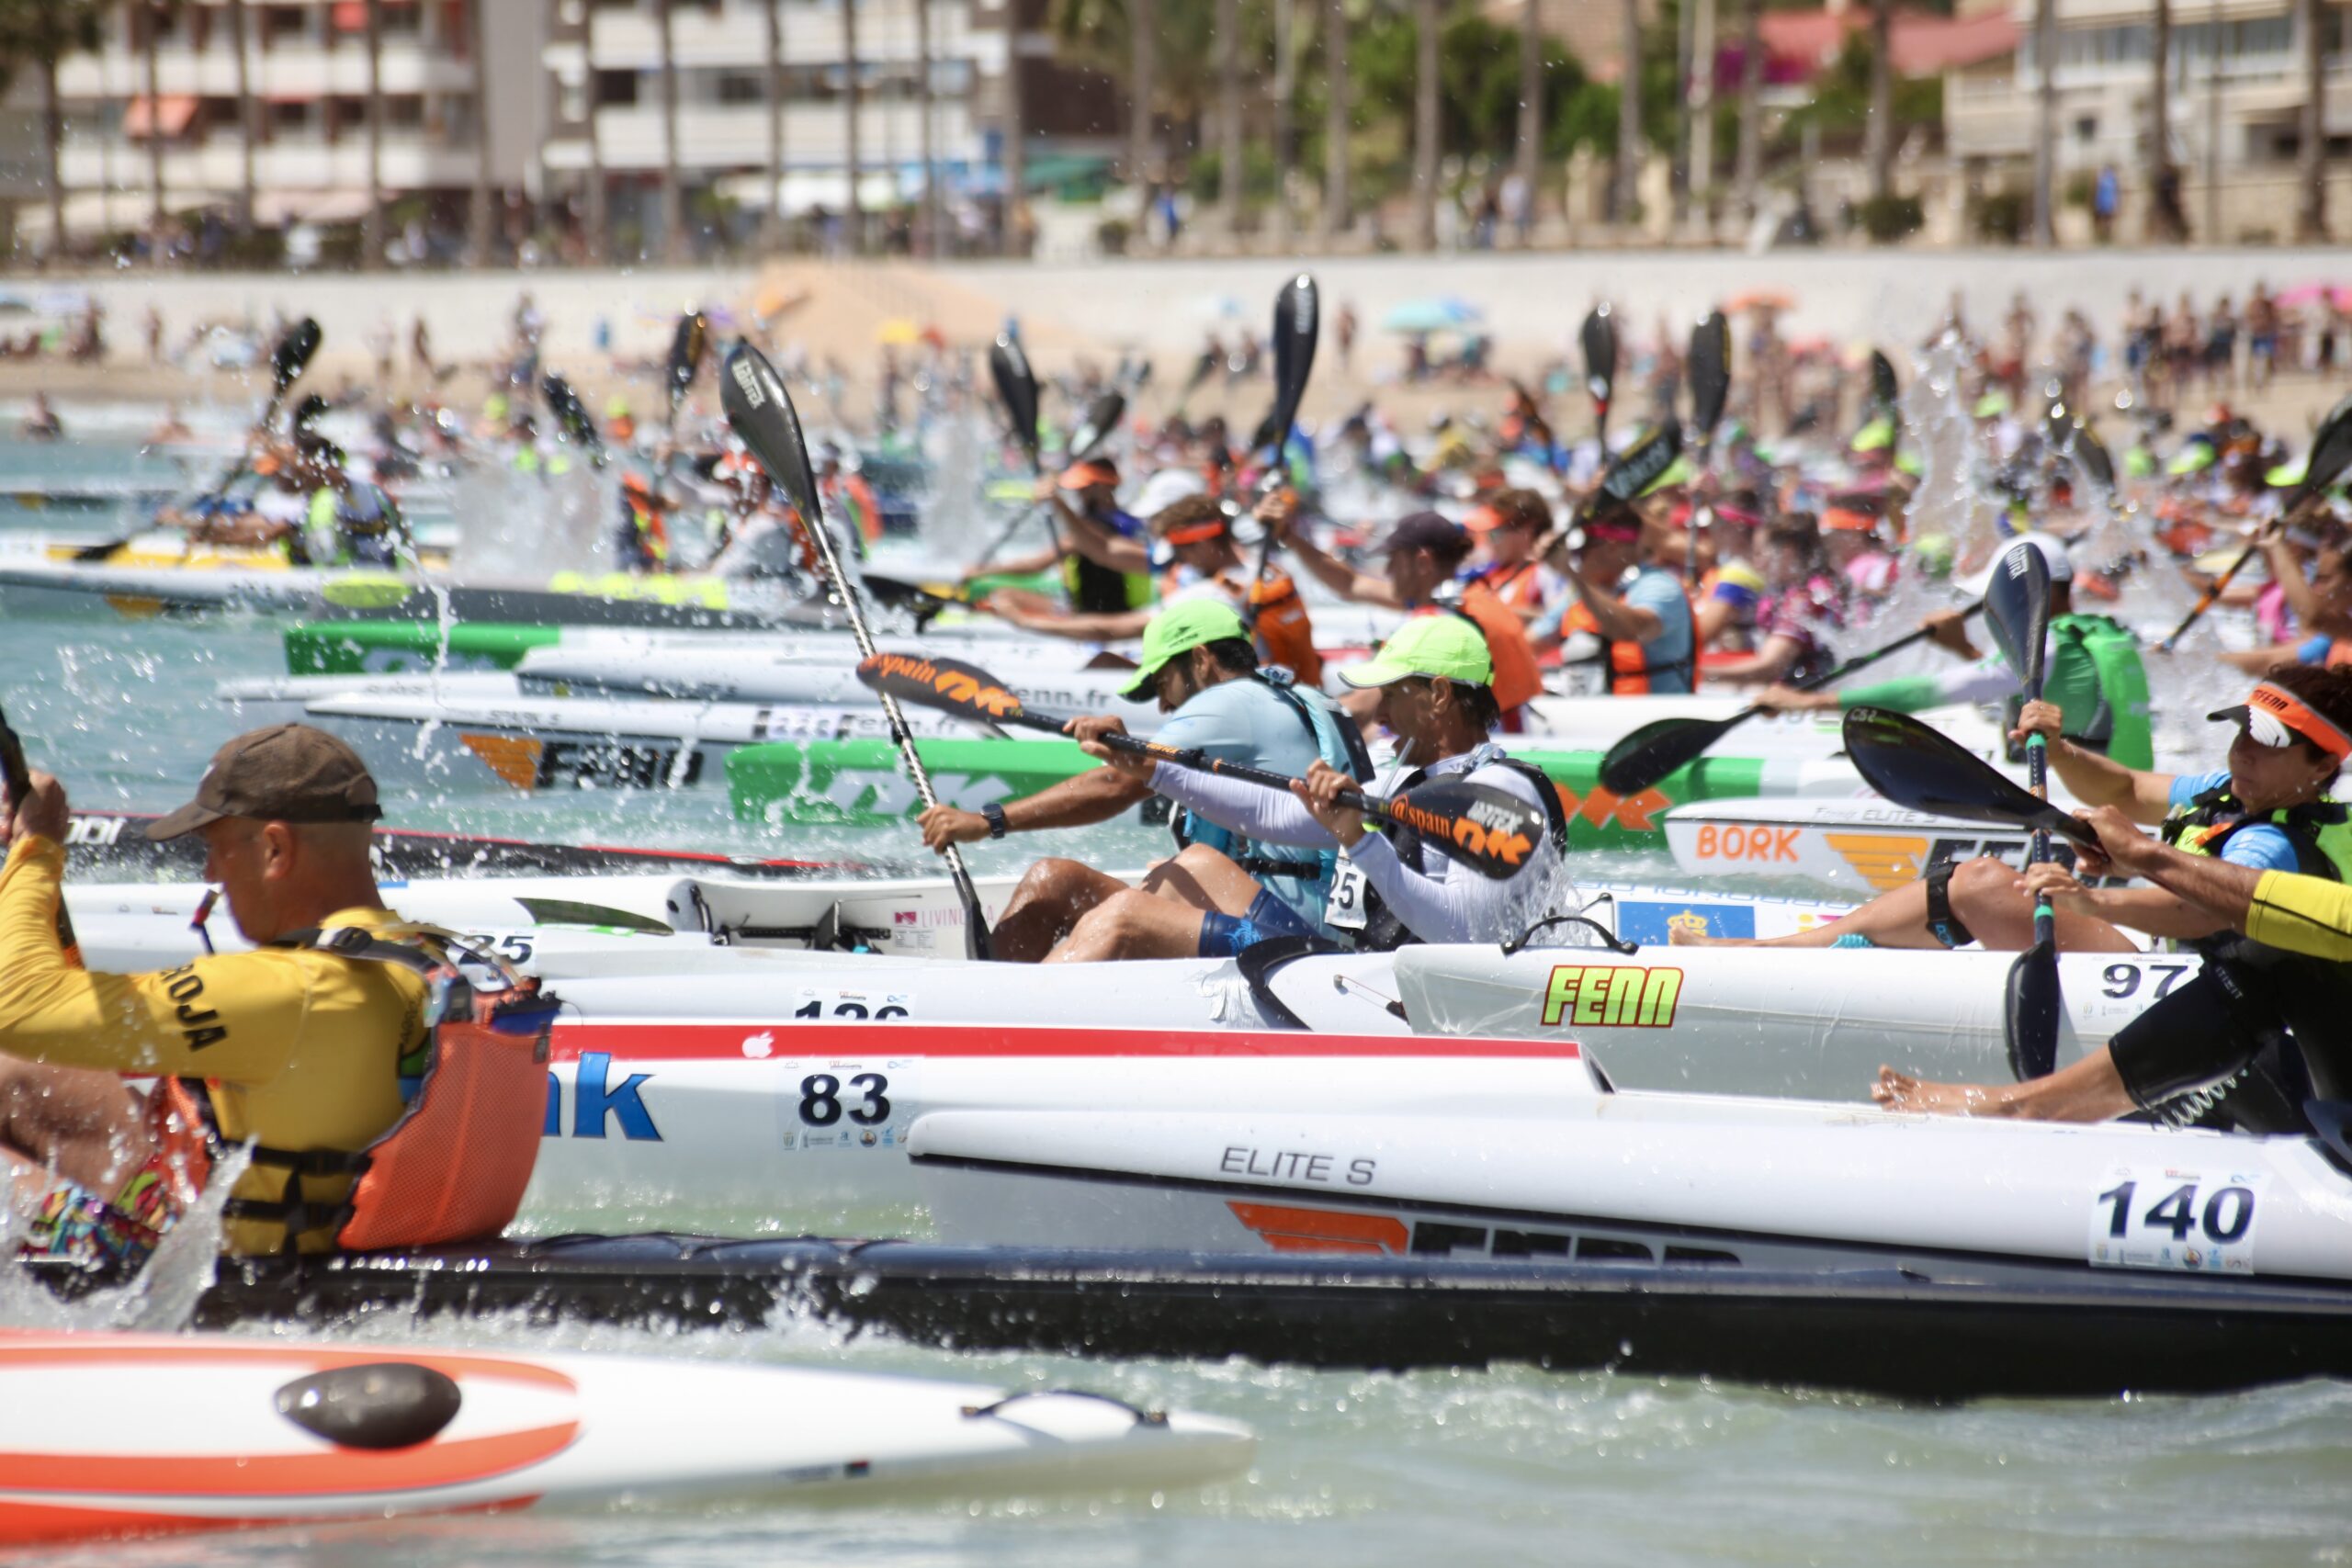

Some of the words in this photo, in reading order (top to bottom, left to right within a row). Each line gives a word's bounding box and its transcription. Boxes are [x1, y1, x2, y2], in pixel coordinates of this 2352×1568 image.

[1695, 824, 1802, 863] BORK
[1542, 965, 1683, 1028] FENN
[2101, 964, 2189, 999] 97
[798, 1073, 890, 1127] 83
[1219, 1146, 1335, 1182] ELITE
[1345, 1160, 1376, 1186] S
[2098, 1181, 2256, 1245] 140
